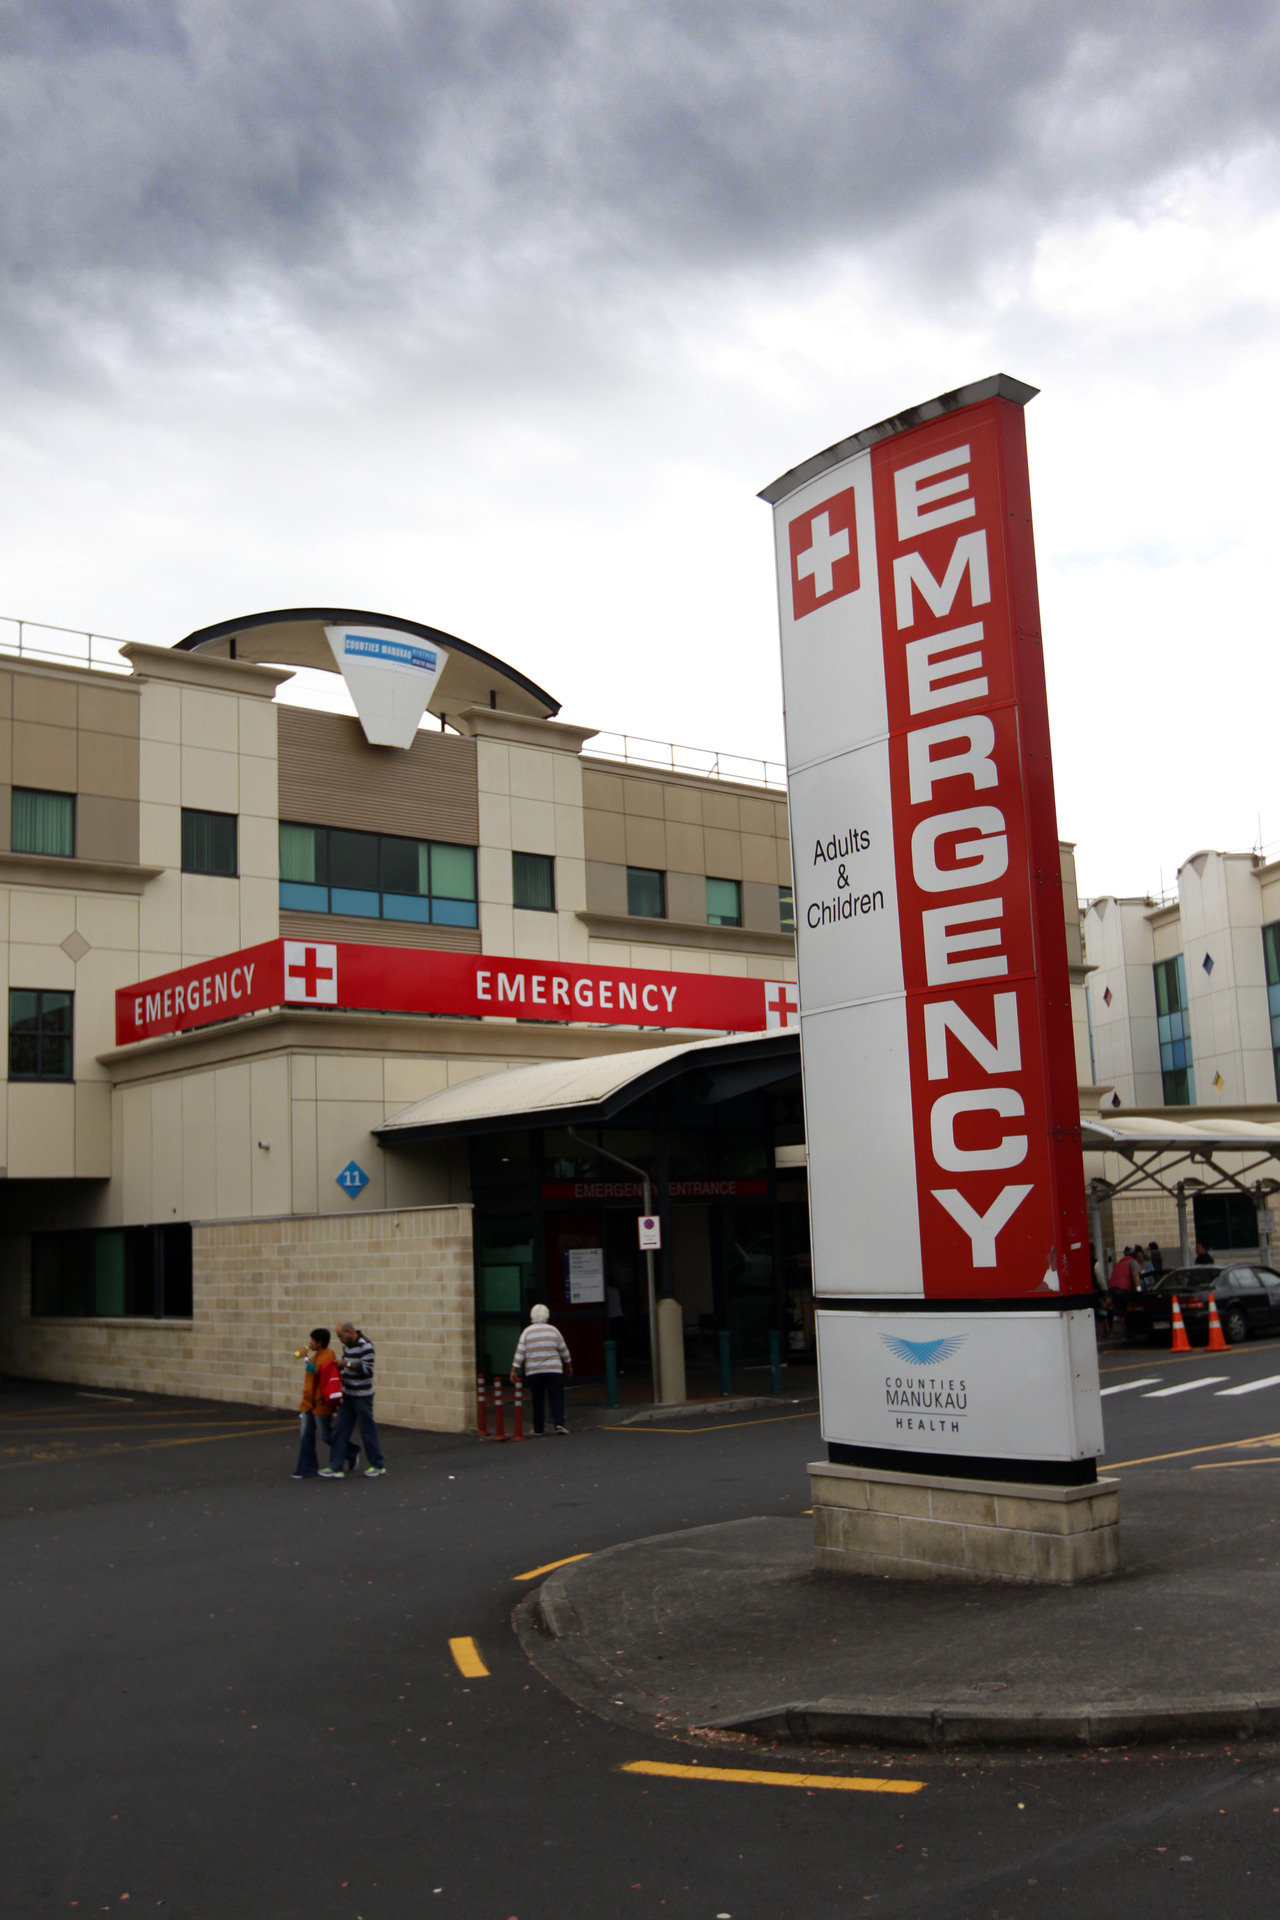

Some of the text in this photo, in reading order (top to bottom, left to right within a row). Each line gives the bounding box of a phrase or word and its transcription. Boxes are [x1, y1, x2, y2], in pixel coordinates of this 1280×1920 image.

[345, 639, 380, 653] COUNTIES
[813, 828, 871, 866] Adults
[892, 444, 1036, 1268] EMERGENCY
[837, 863, 850, 889] &
[807, 890, 884, 928] Children
[134, 962, 255, 1027] EMERGENCY
[476, 970, 677, 1013] EMERGENCY
[343, 1170, 362, 1187] 11
[574, 1180, 737, 1199] EMERGENY ENTRANCE
[885, 1377, 966, 1391] COUNTIES
[886, 1389, 967, 1410] MANUKAU
[895, 1417, 959, 1433] HEALTH
